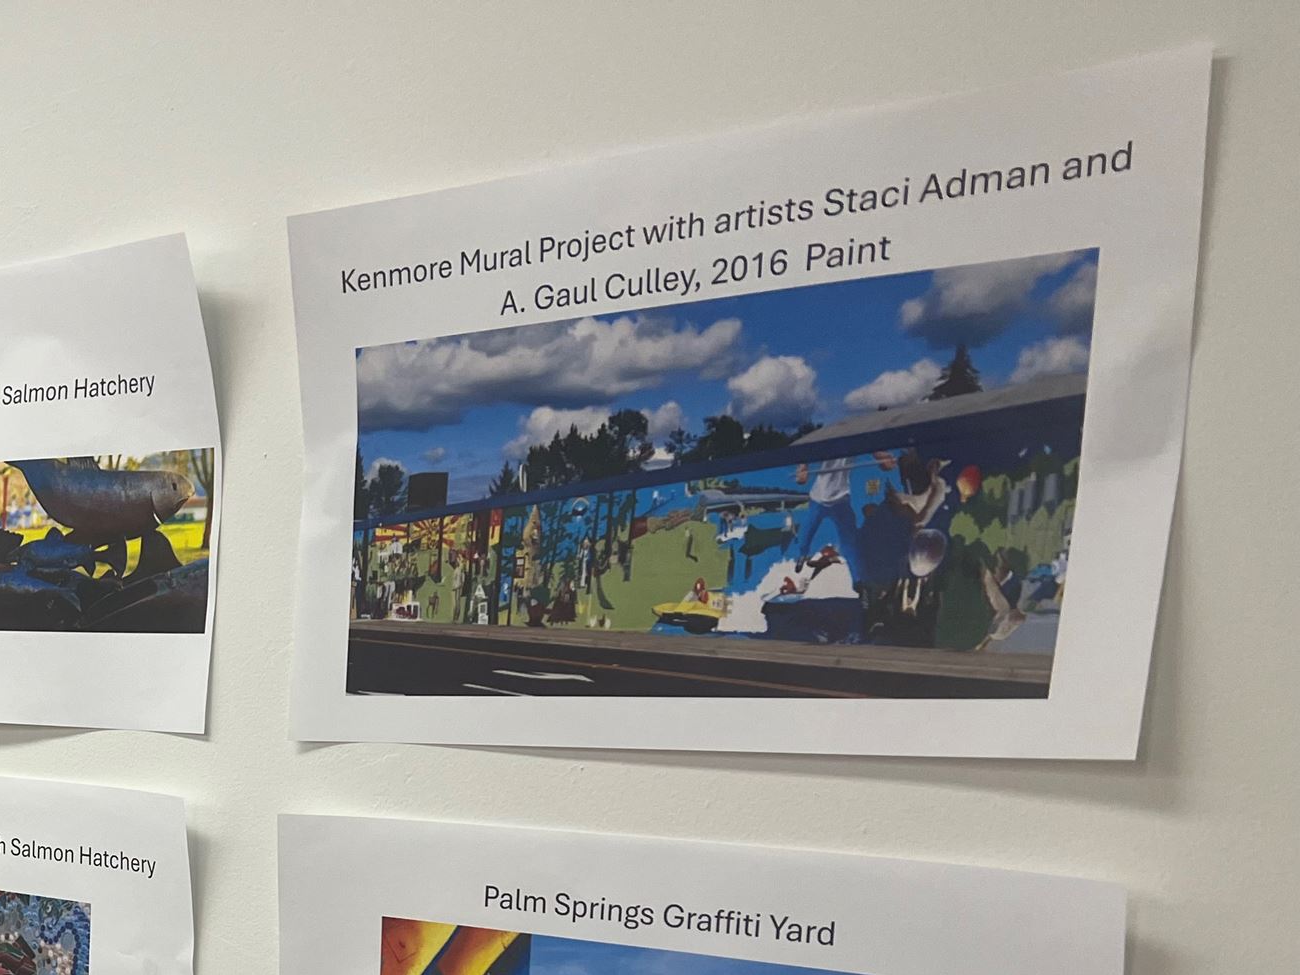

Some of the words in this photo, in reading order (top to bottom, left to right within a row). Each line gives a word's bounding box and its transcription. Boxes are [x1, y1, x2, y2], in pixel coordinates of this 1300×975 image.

[341, 259, 453, 294] Kenmore
[460, 239, 533, 276] Mural
[539, 224, 636, 264] Project
[642, 211, 705, 246] with
[714, 198, 814, 235] artists
[822, 176, 911, 217] Staci
[918, 162, 1050, 204] Adman
[1062, 140, 1133, 181] and
[499, 289, 526, 316] A.
[534, 276, 598, 311] Gaul
[604, 266, 701, 300] Culley,
[710, 248, 789, 286] 2016
[806, 236, 892, 272] Paint
[1, 383, 69, 406] Salmon
[73, 373, 156, 400] Hatchery
[10, 837, 75, 864] Salmon
[79, 845, 157, 880] Hatchery
[484, 884, 547, 914] Palm
[553, 892, 655, 931] Springs
[663, 903, 762, 938] Graffiti
[768, 913, 836, 947] Yard
